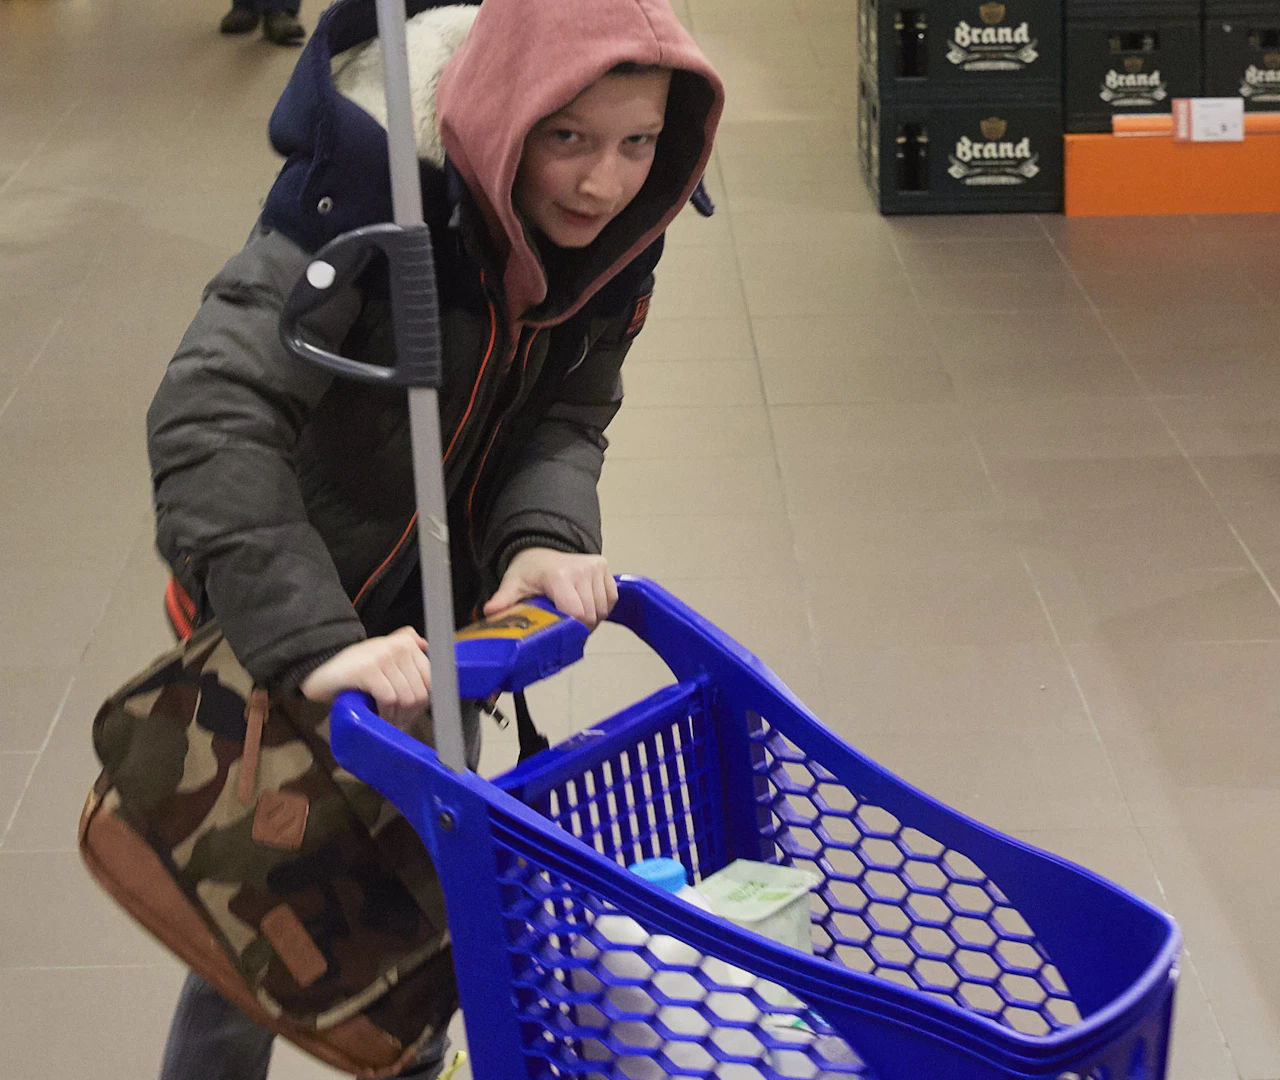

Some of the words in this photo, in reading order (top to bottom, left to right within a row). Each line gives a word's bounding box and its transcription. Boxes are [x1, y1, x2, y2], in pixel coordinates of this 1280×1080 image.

[954, 20, 1030, 48] Brand
[1106, 69, 1162, 90] Brand
[956, 136, 1032, 163] Brand
